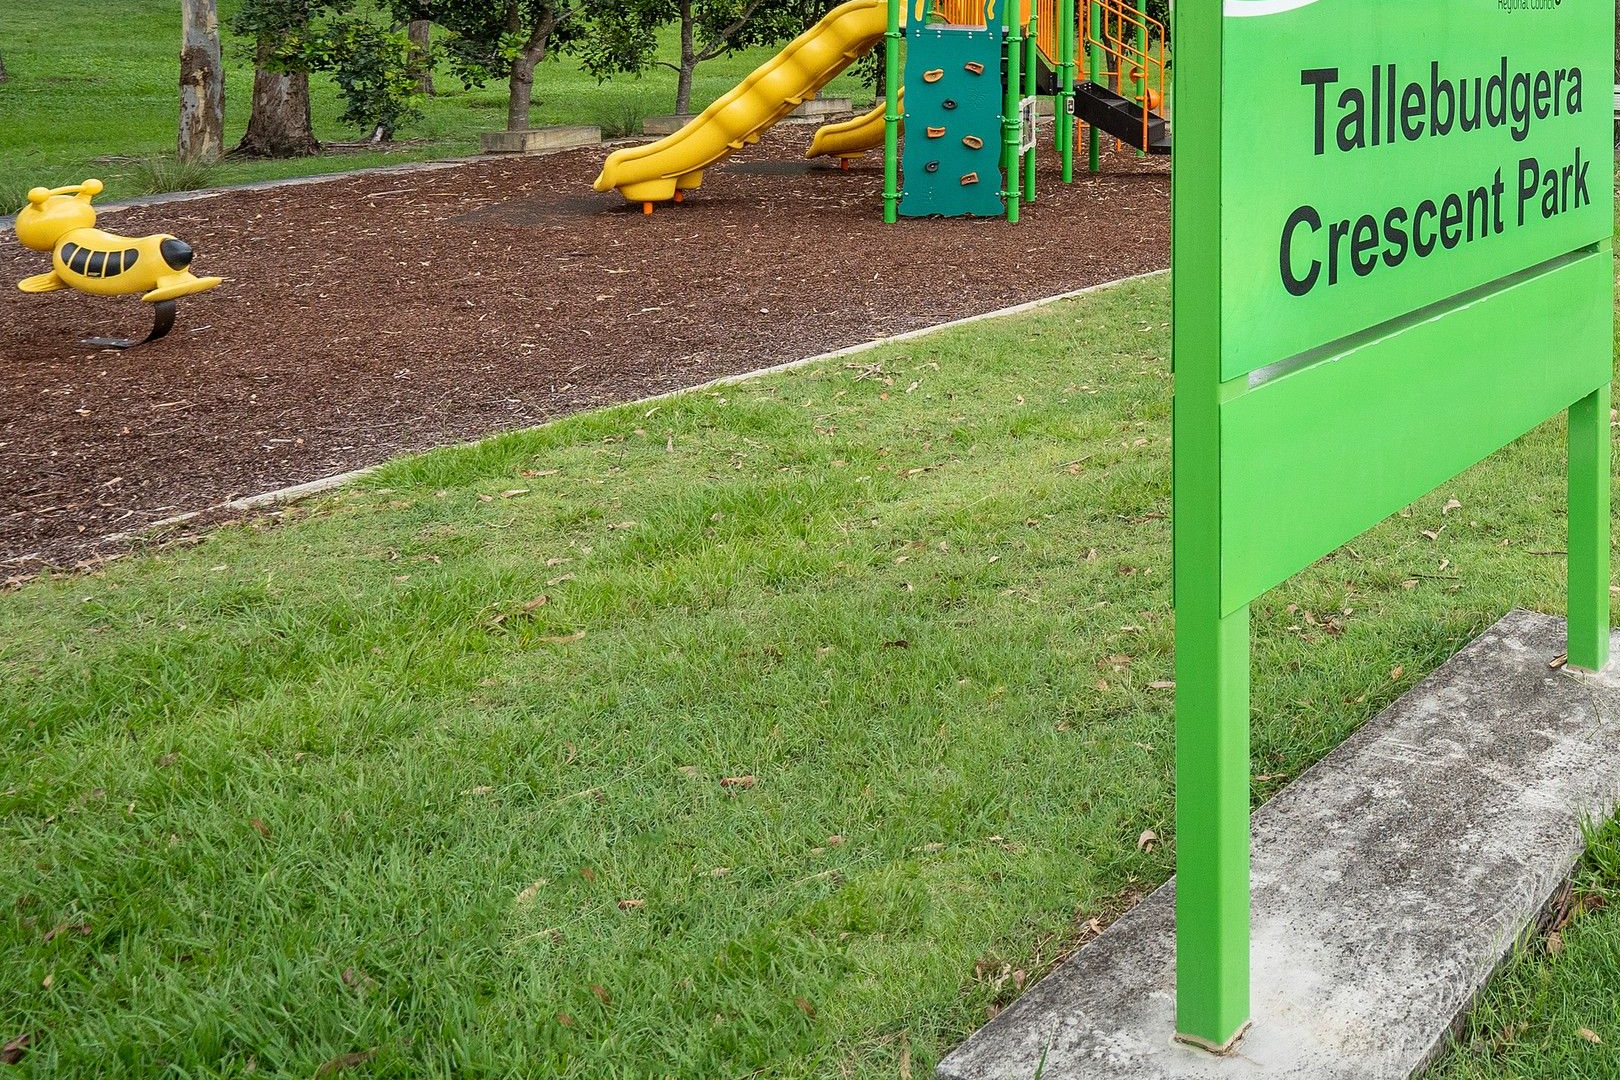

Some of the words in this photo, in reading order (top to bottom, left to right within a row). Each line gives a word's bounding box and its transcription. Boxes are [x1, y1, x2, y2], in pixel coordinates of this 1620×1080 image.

[1300, 56, 1583, 156] Tallebudgera
[1279, 166, 1504, 297] Crescent
[1517, 146, 1591, 227] Park
